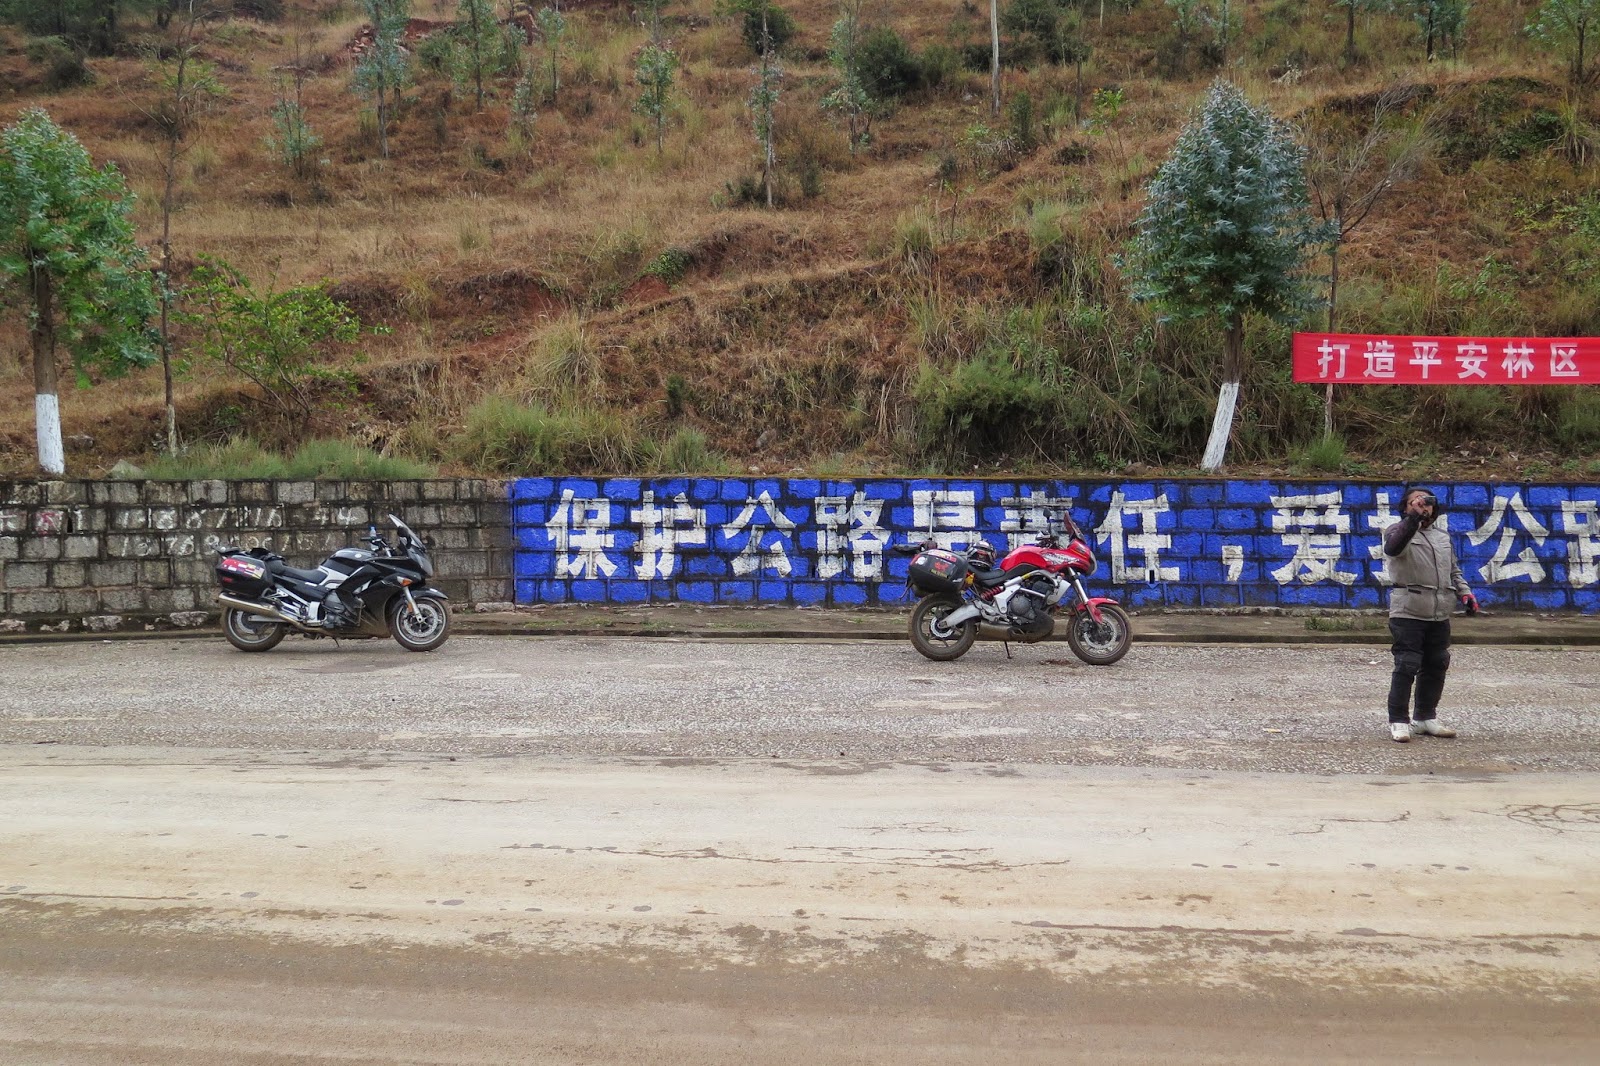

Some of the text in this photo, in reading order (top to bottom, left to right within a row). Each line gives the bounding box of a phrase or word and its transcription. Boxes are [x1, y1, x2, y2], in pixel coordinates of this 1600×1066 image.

[1317, 339, 1580, 379] 打造平安林区
